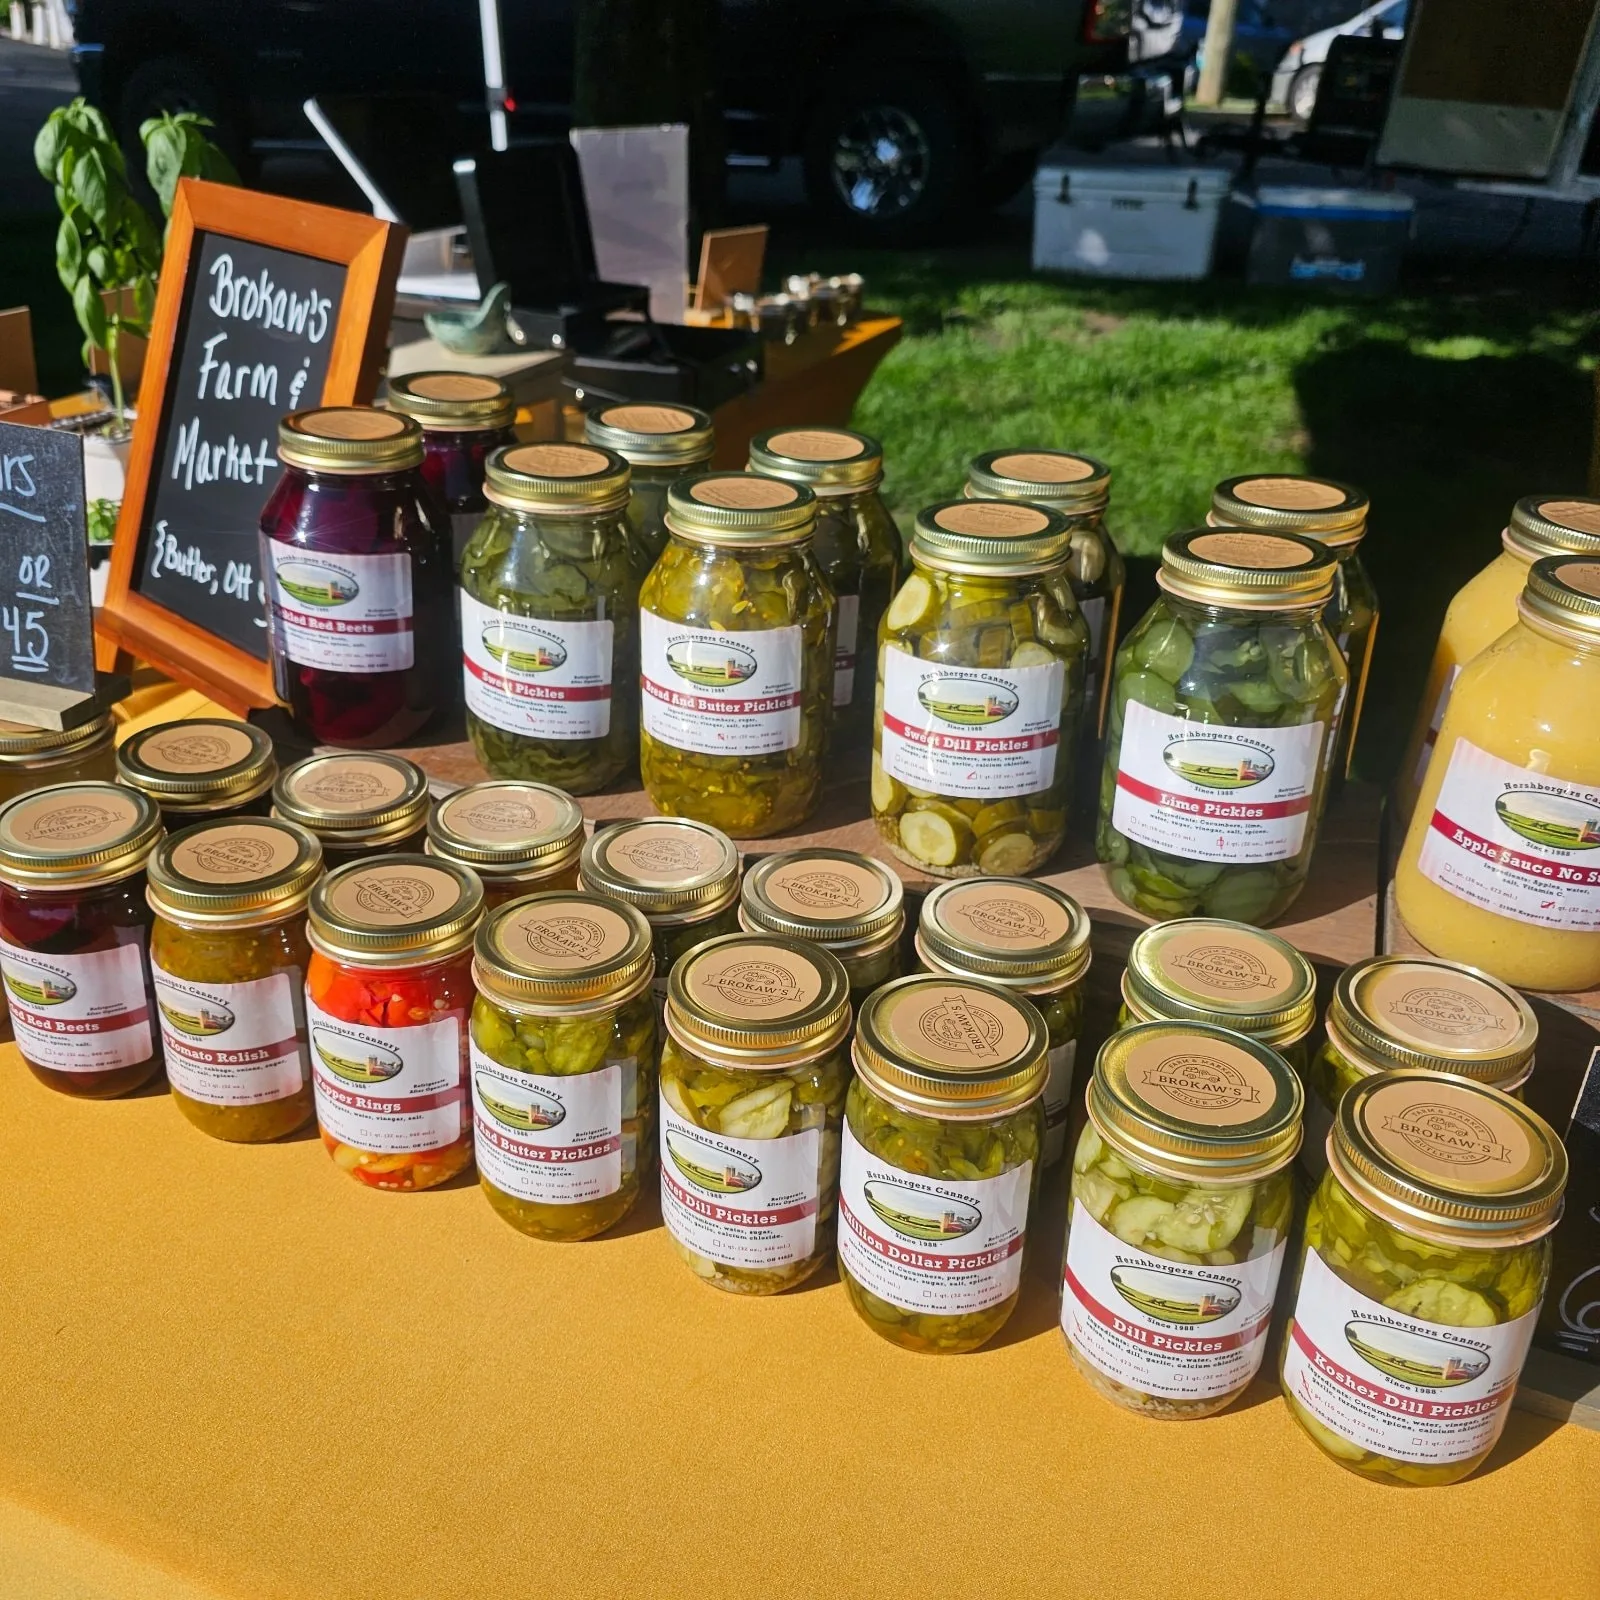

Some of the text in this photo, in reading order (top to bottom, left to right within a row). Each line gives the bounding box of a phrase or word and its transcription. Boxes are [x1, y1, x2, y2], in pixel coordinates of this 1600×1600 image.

[209, 253, 332, 343] Brokaw's
[199, 332, 280, 404] Farm
[171, 416, 278, 491] Market
[19, 555, 53, 588] OR
[223, 560, 253, 601] OH
[3, 606, 49, 663] 45
[309, 617, 333, 631] Red
[336, 622, 374, 633] Beets
[516, 682, 565, 699] Pickles
[920, 670, 1018, 690] Herhbergers Cannery
[672, 695, 695, 708] And
[697, 699, 740, 713] Butter
[744, 698, 793, 712] Pickles
[943, 740, 971, 751] Dill
[975, 739, 1028, 751] Pickles
[1168, 731, 1275, 754] Herhbergers Cannery
[1194, 786, 1214, 795] Since
[1584, 793, 1600, 805] Ca
[1160, 793, 1263, 817] Lime Pickles
[468, 811, 527, 827] BROKAW'S
[203, 847, 260, 870] BROKAW'S
[631, 847, 690, 866] BROKAW'S
[1452, 830, 1600, 883] Apple Sauce No S
[367, 881, 413, 914] BROKAW'S
[790, 881, 851, 903] BROKAW'S
[1522, 884, 1565, 898] Vitamin C.
[972, 909, 1037, 933] BROKAW'S
[533, 922, 590, 955] BROKAW'S
[731, 963, 752, 973] FARM
[762, 964, 791, 982] MARKET
[1187, 960, 1261, 982] BROKAW'S
[718, 977, 789, 996] BROKAW'S
[27, 1014, 52, 1030] Red
[55, 1022, 100, 1032] Beets
[1404, 1005, 1487, 1024] BROKAW'S
[951, 1005, 986, 1050] BROKAW'S
[170, 1039, 213, 1061] Tomato
[217, 1050, 269, 1062] Relish
[358, 1032, 400, 1052] Cannery
[1168, 1058, 1189, 1068] FARM
[1201, 1059, 1236, 1078] MARKET
[316, 1075, 401, 1112] Pepper Rings
[521, 1079, 563, 1100] Cannery
[1159, 1075, 1242, 1097] BROKAW'S
[1172, 1089, 1215, 1106] BUTLER,
[1411, 1107, 1435, 1117] FARM
[1448, 1110, 1486, 1134] MARKET
[479, 1125, 611, 1160] And Butter Pickles
[1399, 1122, 1492, 1153] BROKAW'S
[716, 1141, 760, 1164] Cannery
[1414, 1139, 1460, 1161] BUTLER,
[866, 1170, 981, 1206] Hershbergers Cannery
[685, 1194, 712, 1214] Dill
[715, 1209, 778, 1224] Pickles
[843, 1204, 1008, 1269] Million Dollar Pickles
[895, 1232, 916, 1245] Since
[897, 1265, 945, 1281] Cucumbers,
[1115, 1255, 1243, 1286] Hershbergers Cannery
[1112, 1317, 1223, 1352] Dill Pickles
[1147, 1317, 1171, 1330] Since
[1350, 1309, 1492, 1351] Hershbergers Cannery
[1087, 1314, 1131, 1348] Ingredients:
[1132, 1345, 1184, 1363] Cucumbers,
[1107, 1339, 1124, 1353] salt,
[1126, 1348, 1143, 1360] dill,
[1146, 1357, 1175, 1368] garlic,
[1177, 1361, 1211, 1369] calcium
[1307, 1363, 1352, 1403] Ingredients:
[1354, 1398, 1411, 1424] Cucumbers,
[1412, 1420, 1442, 1429] water,
[1315, 1351, 1499, 1418] Kosher Dill Pickles
[1384, 1375, 1437, 1395] Since 1988
[1311, 1377, 1337, 1399] garlic,
[1338, 1396, 1380, 1421] turmeric,
[1382, 1417, 1416, 1432] spices,
